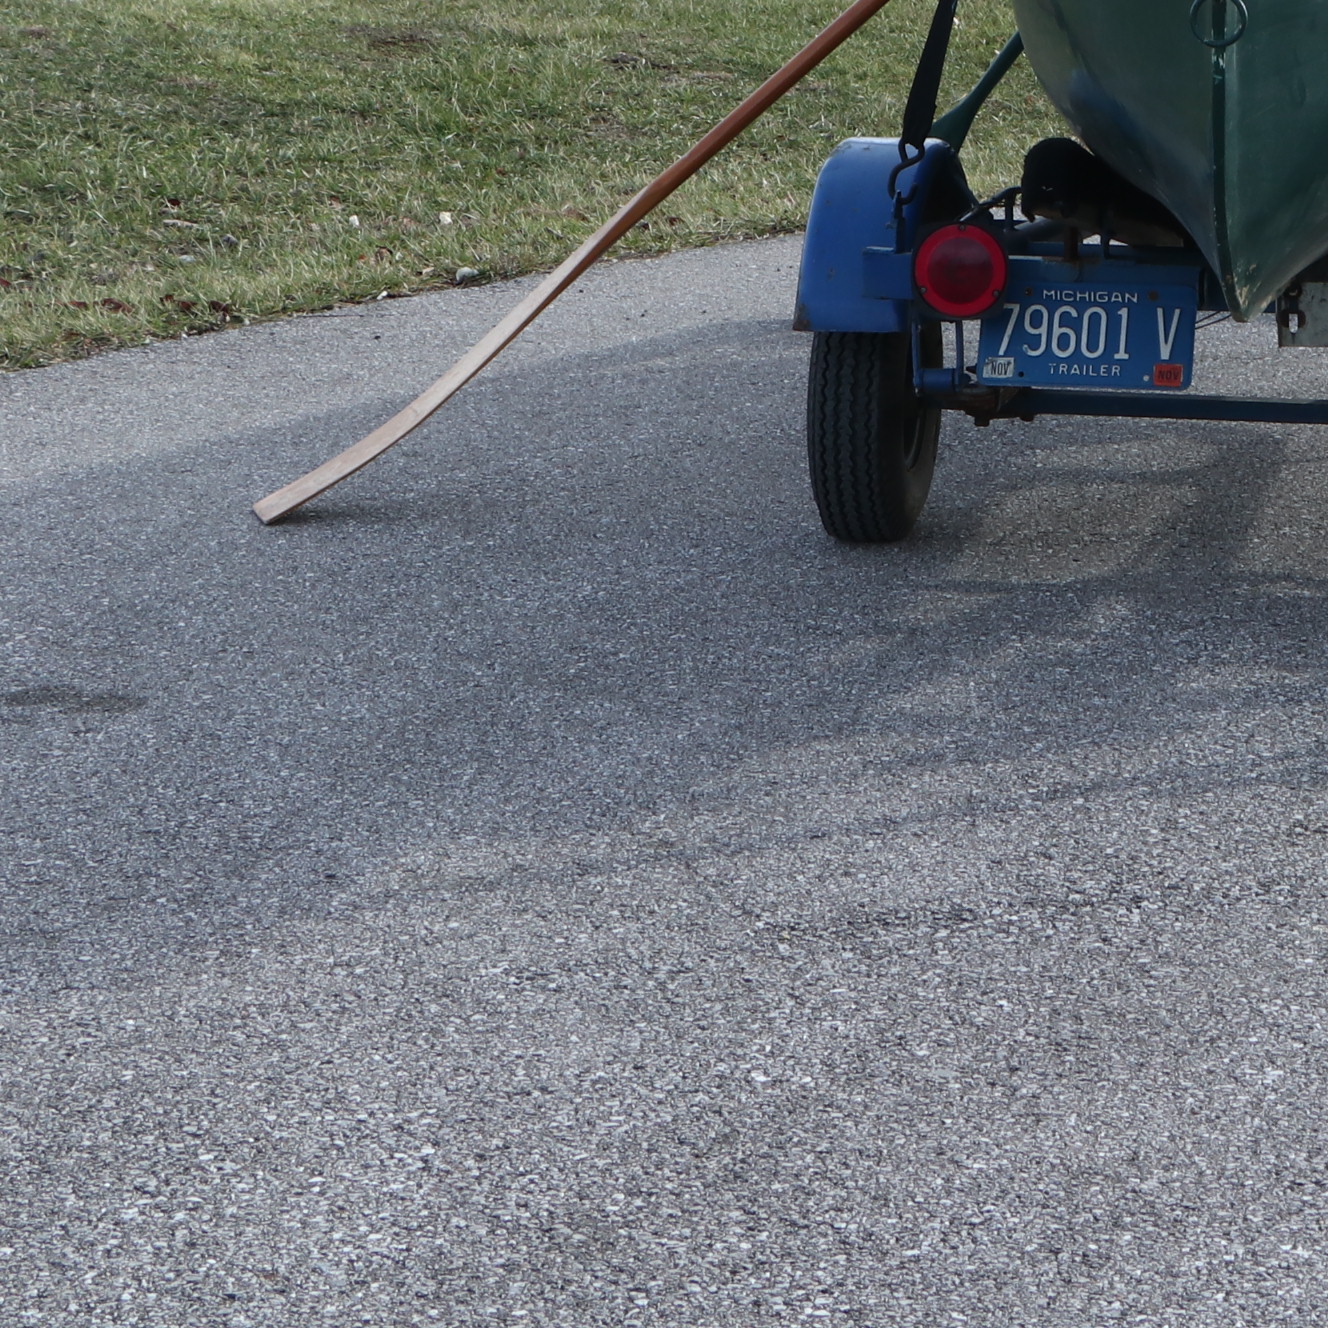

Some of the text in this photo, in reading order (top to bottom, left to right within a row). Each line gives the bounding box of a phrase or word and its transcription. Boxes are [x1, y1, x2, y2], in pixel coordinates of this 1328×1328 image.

[1043, 289, 1138, 304] MICHIGAN
[998, 303, 1181, 360] 79601 V
[990, 361, 1010, 376] NOV
[1048, 363, 1121, 377] TRAILER
